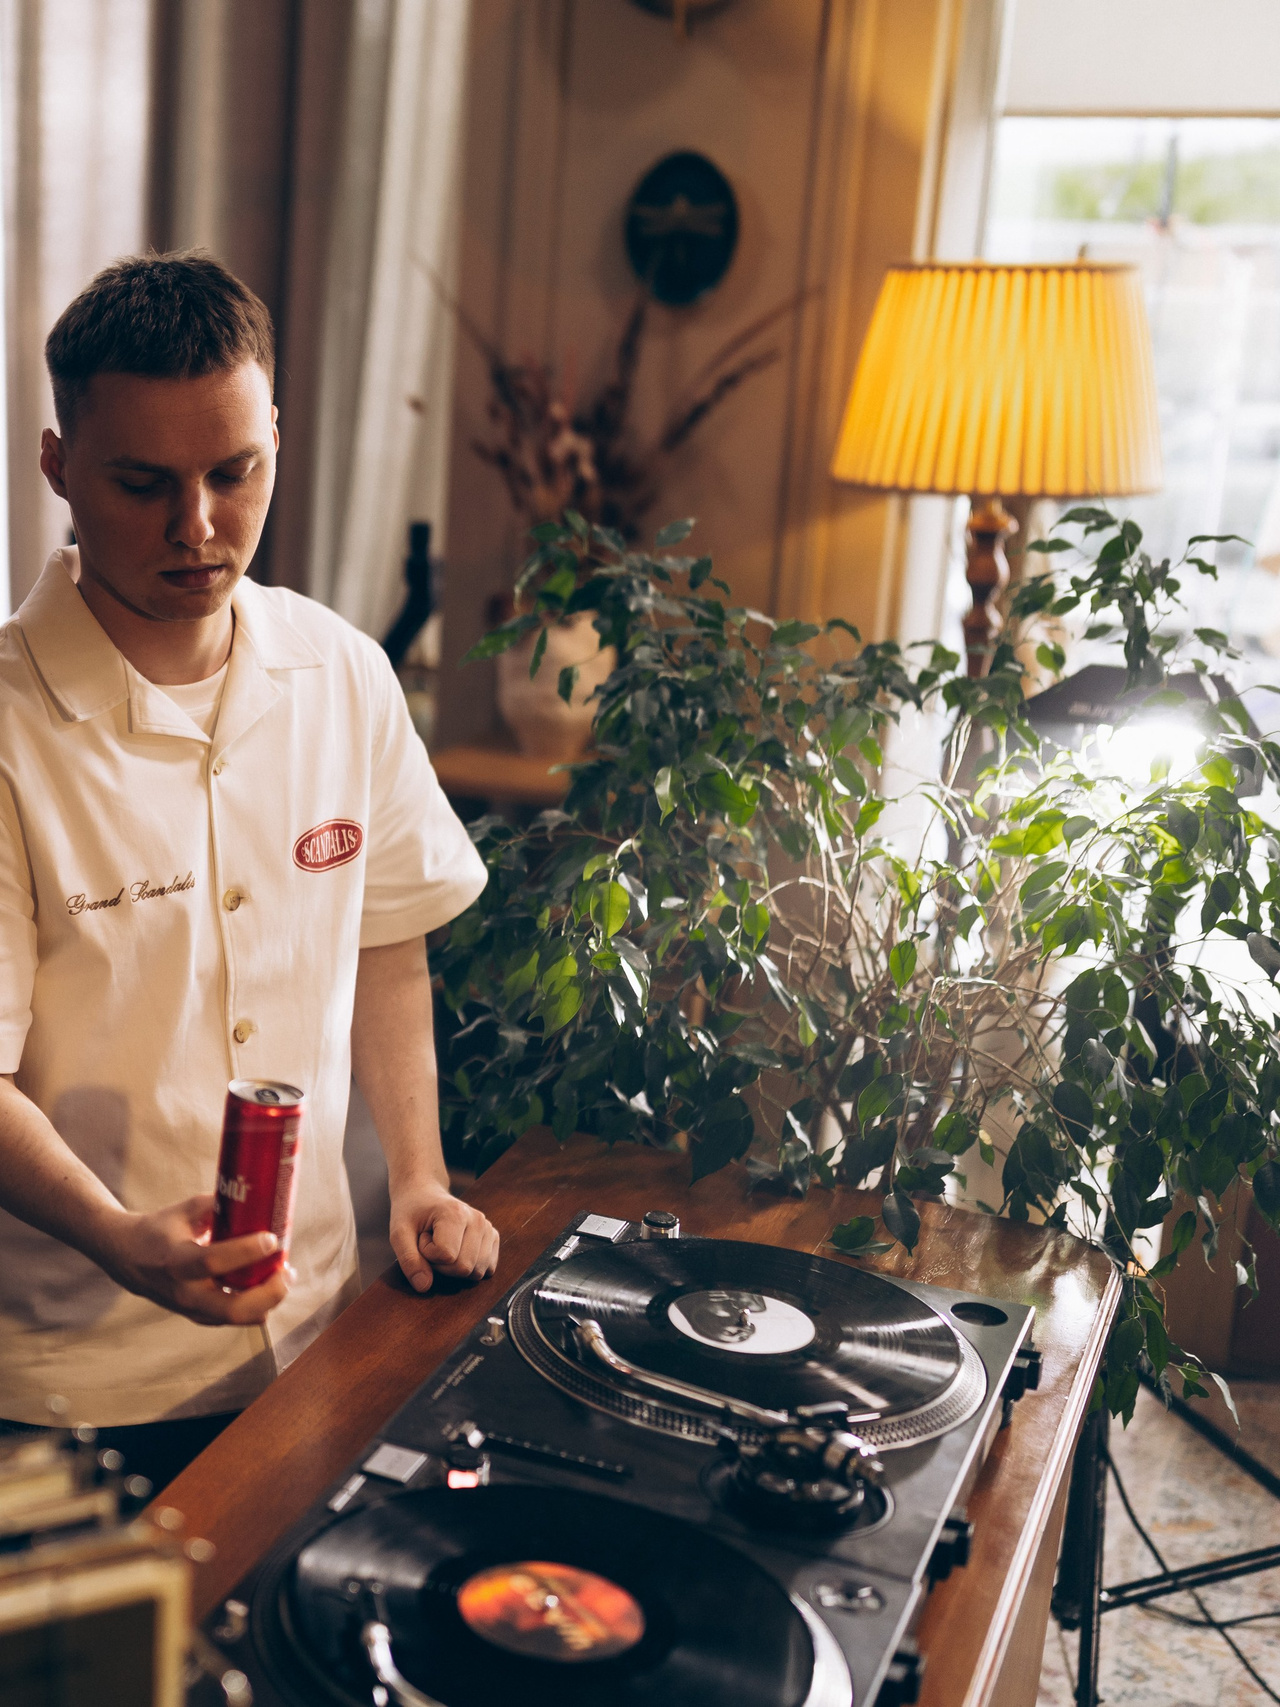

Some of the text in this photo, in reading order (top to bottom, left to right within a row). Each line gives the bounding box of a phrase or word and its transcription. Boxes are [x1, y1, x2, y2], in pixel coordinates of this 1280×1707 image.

[301, 828, 359, 863] SCANDALIS
[65, 870, 196, 916] Grand Scandalis
